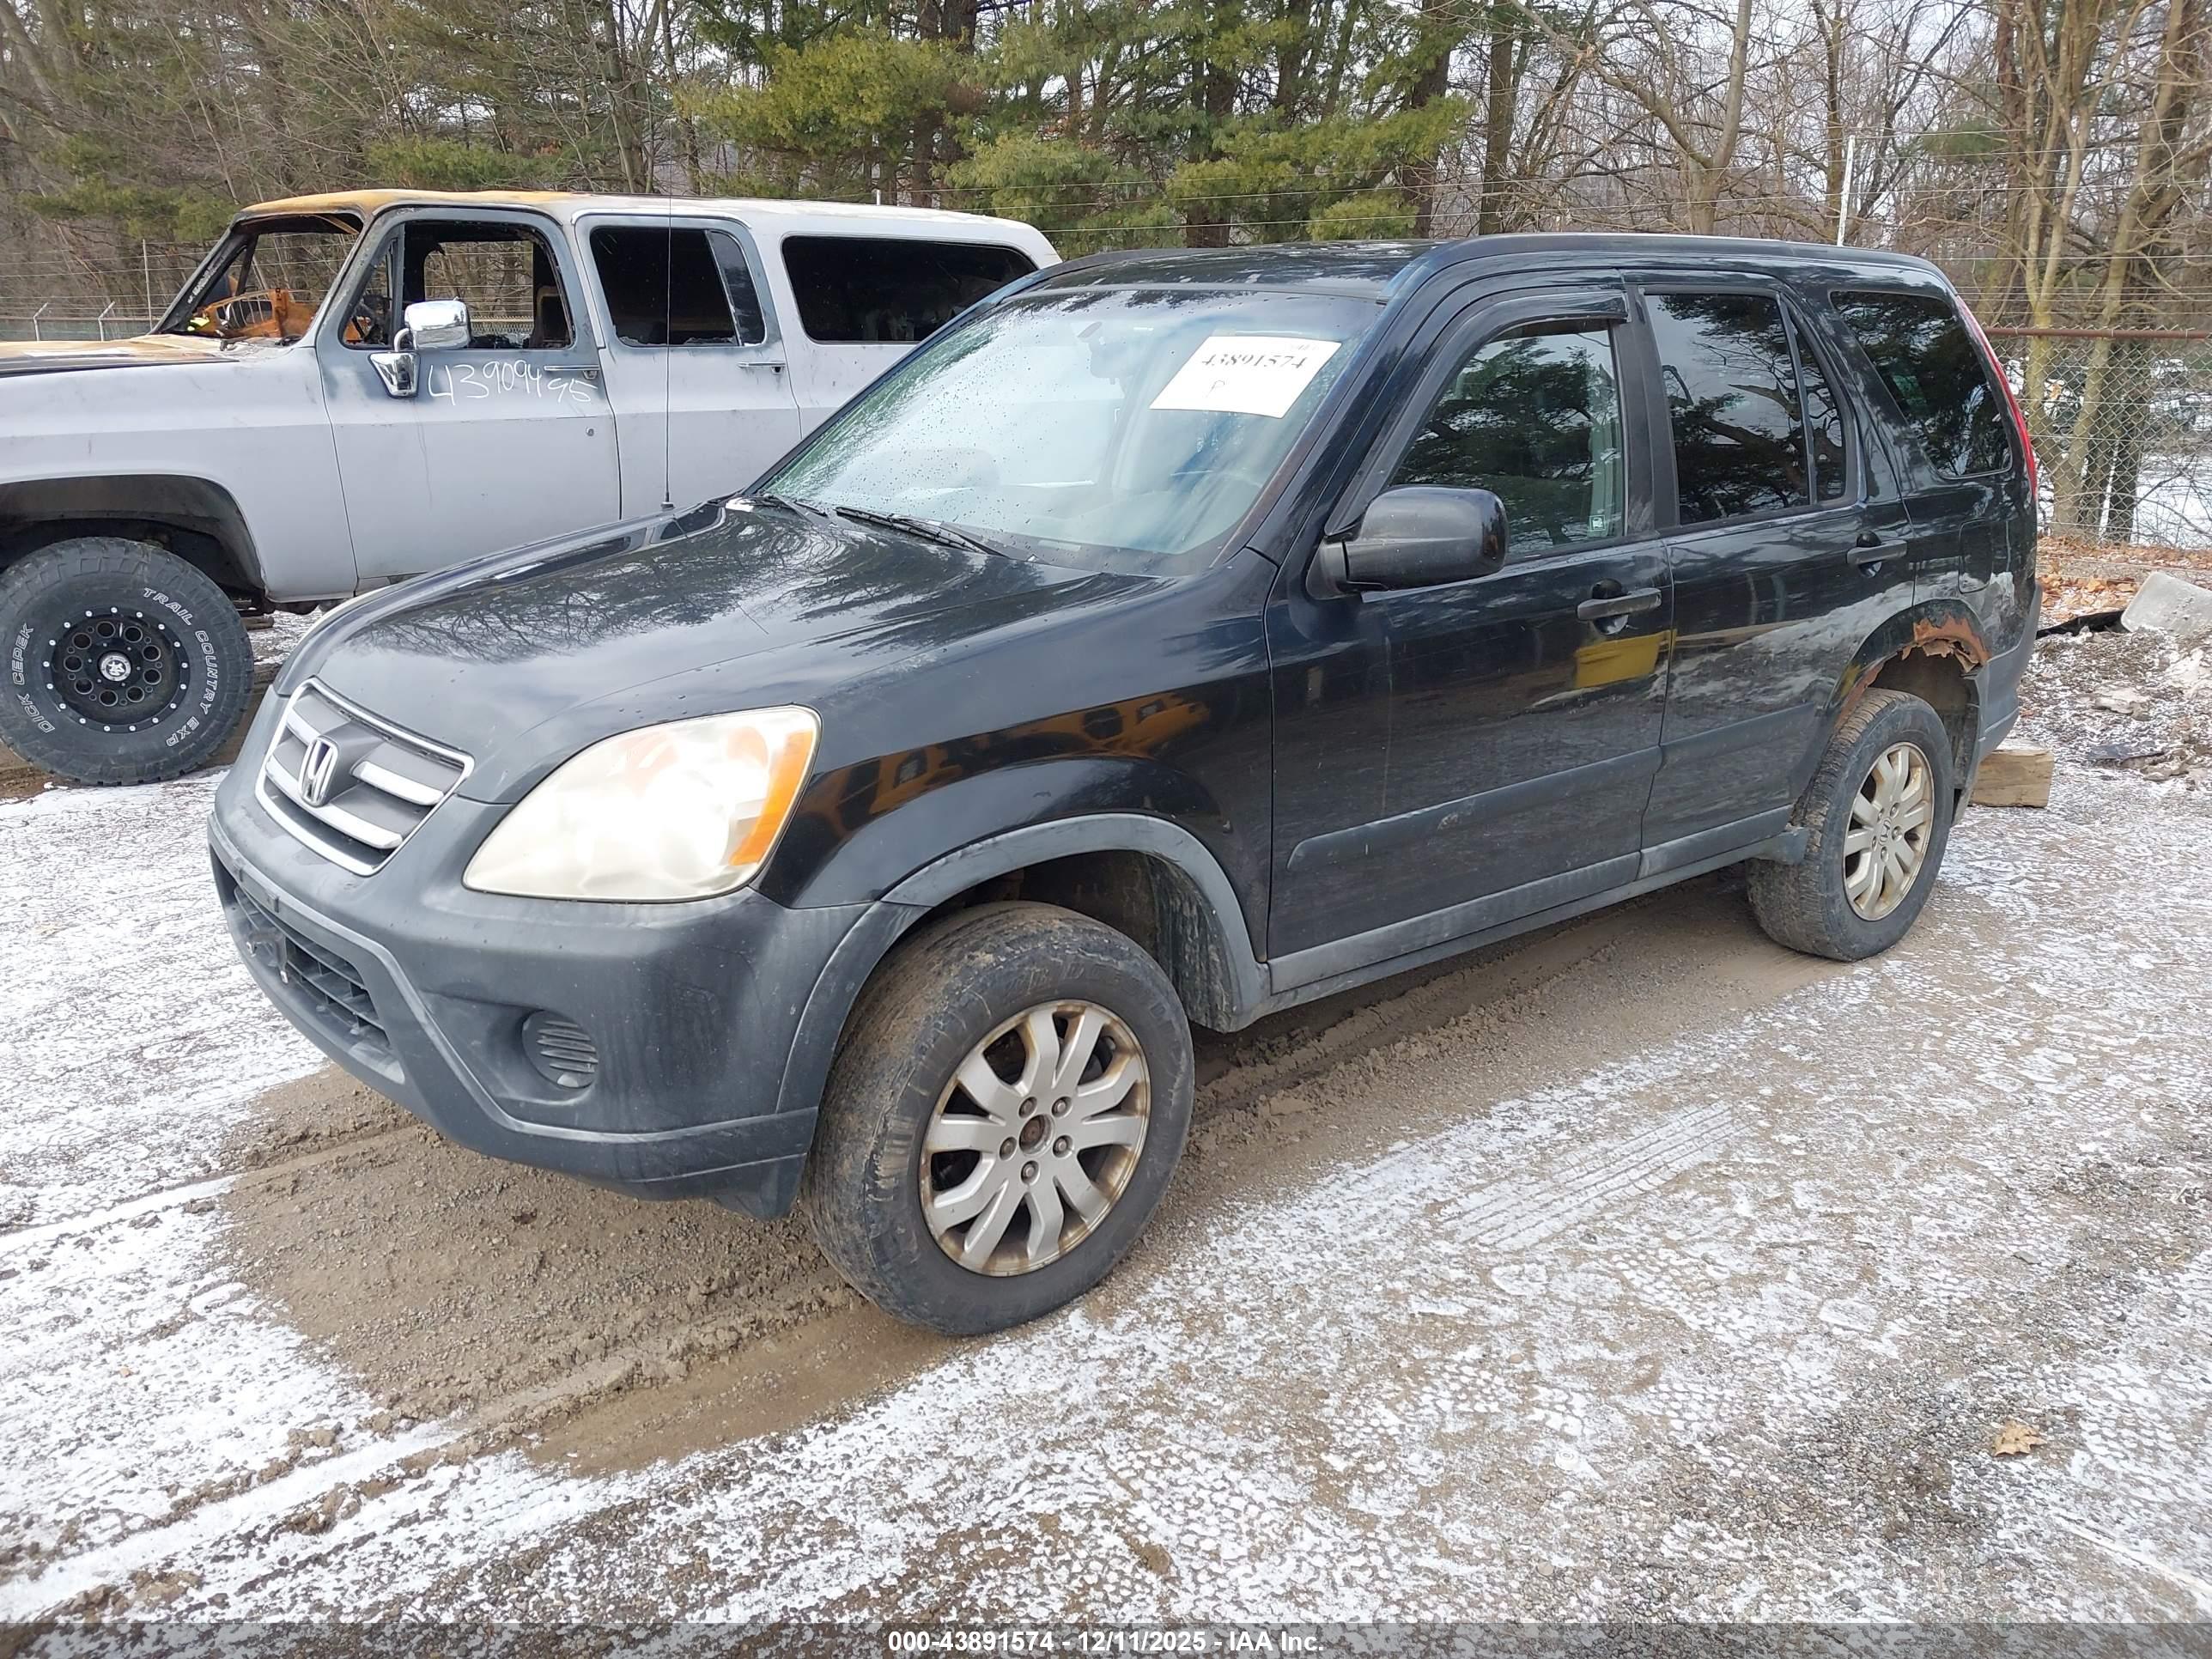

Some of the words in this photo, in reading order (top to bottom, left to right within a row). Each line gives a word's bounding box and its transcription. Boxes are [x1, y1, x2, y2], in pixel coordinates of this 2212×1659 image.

[1201, 353, 1309, 370] 43891574
[143, 587, 192, 626] TRAIL
[12, 622, 34, 686] CEPEK
[195, 630, 218, 715] COUNTRY
[16, 693, 56, 733] DICK
[166, 716, 200, 747] EXP
